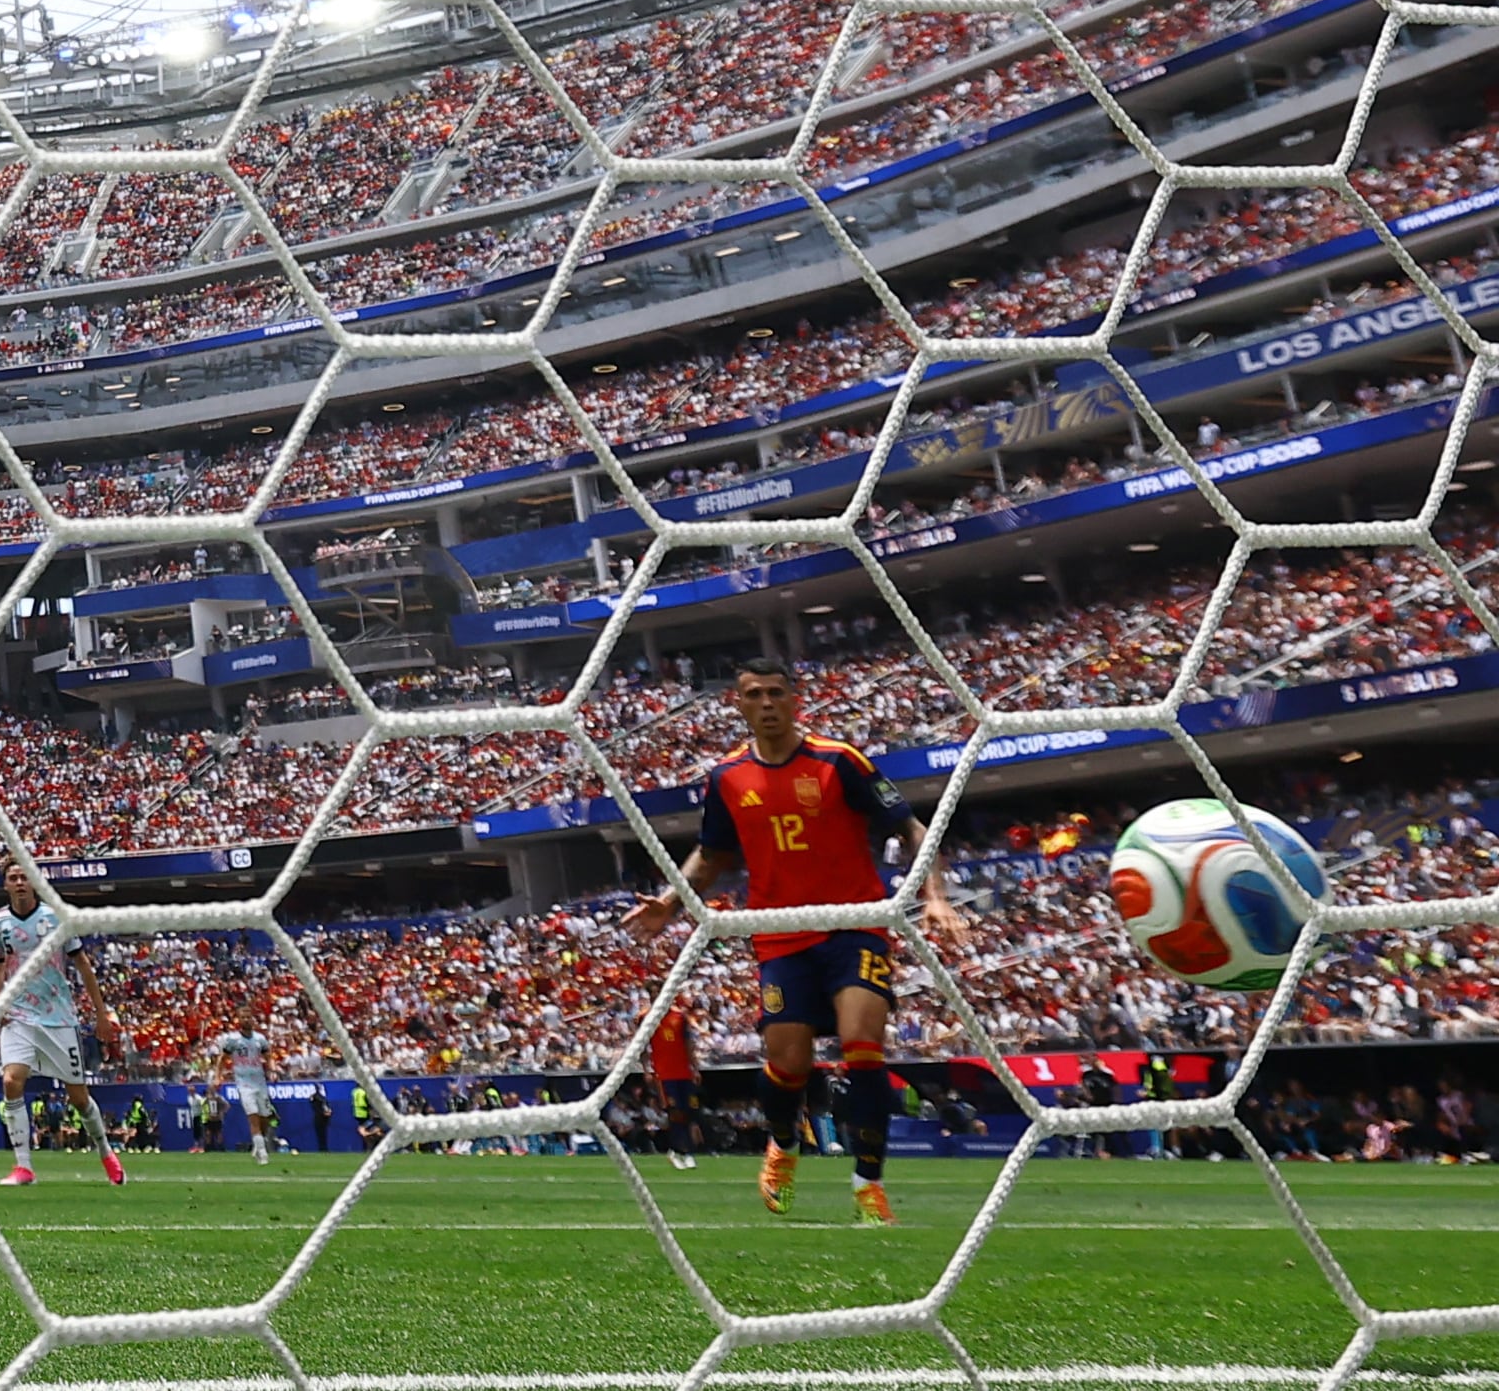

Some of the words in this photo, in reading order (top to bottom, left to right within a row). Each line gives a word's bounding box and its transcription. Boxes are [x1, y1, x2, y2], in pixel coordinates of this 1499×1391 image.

[1239, 332, 1322, 373] LOS
[1161, 460, 1223, 488] WOLD
[364, 492, 385, 505] FIFA
[385, 487, 419, 502] WORLD
[696, 477, 793, 516] #FIFAWorldCup
[1017, 735, 1049, 755] CUP
[1049, 728, 1108, 750] 2026
[769, 814, 810, 852] 12
[233, 852, 249, 867] CC
[4, 937, 15, 955] 5
[857, 948, 892, 990] 12
[69, 1046, 79, 1067] 5
[1034, 1057, 1056, 1081] 1
